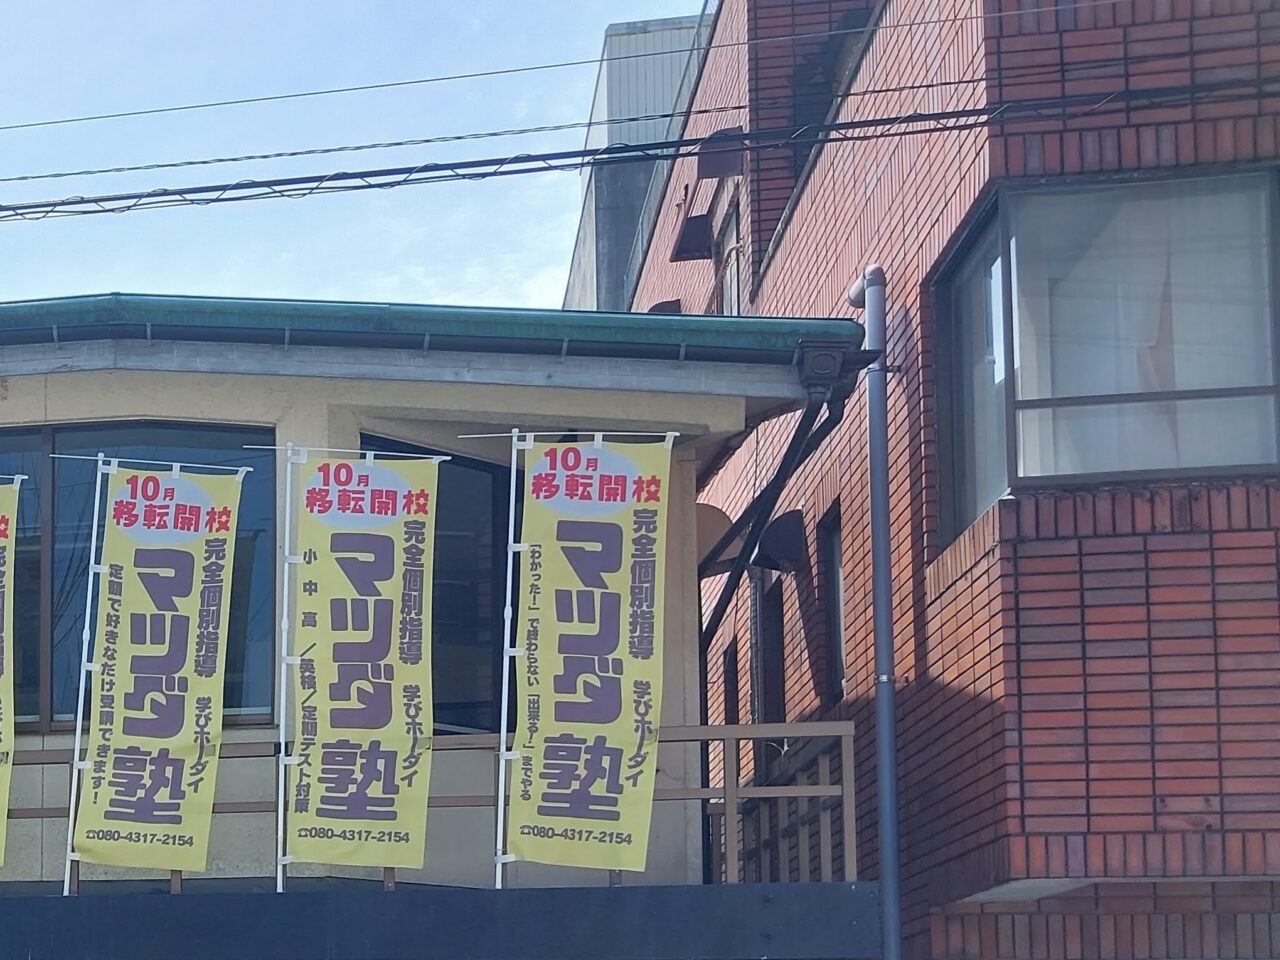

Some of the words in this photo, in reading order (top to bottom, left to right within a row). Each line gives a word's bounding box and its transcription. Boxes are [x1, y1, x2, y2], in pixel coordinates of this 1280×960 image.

[543, 447, 598, 472] 10月
[125, 475, 175, 501] 10月
[317, 463, 369, 487] 10月
[531, 473, 661, 503] 移転開校
[112, 500, 232, 533] 移転開校
[306, 488, 429, 517] 移転開校
[399, 520, 426, 665] 完全個別指導
[628, 508, 657, 660] 完全個別指導
[194, 538, 227, 678] 完全個別指導
[315, 532, 400, 821] マツダ塾
[536, 520, 624, 821] マツダ塾
[103, 548, 195, 825] マツダ塾
[96, 829, 194, 847] 080-4317-2154
[310, 827, 410, 844] 080-4317-2154
[531, 826, 632, 845] 080-4317-2154
